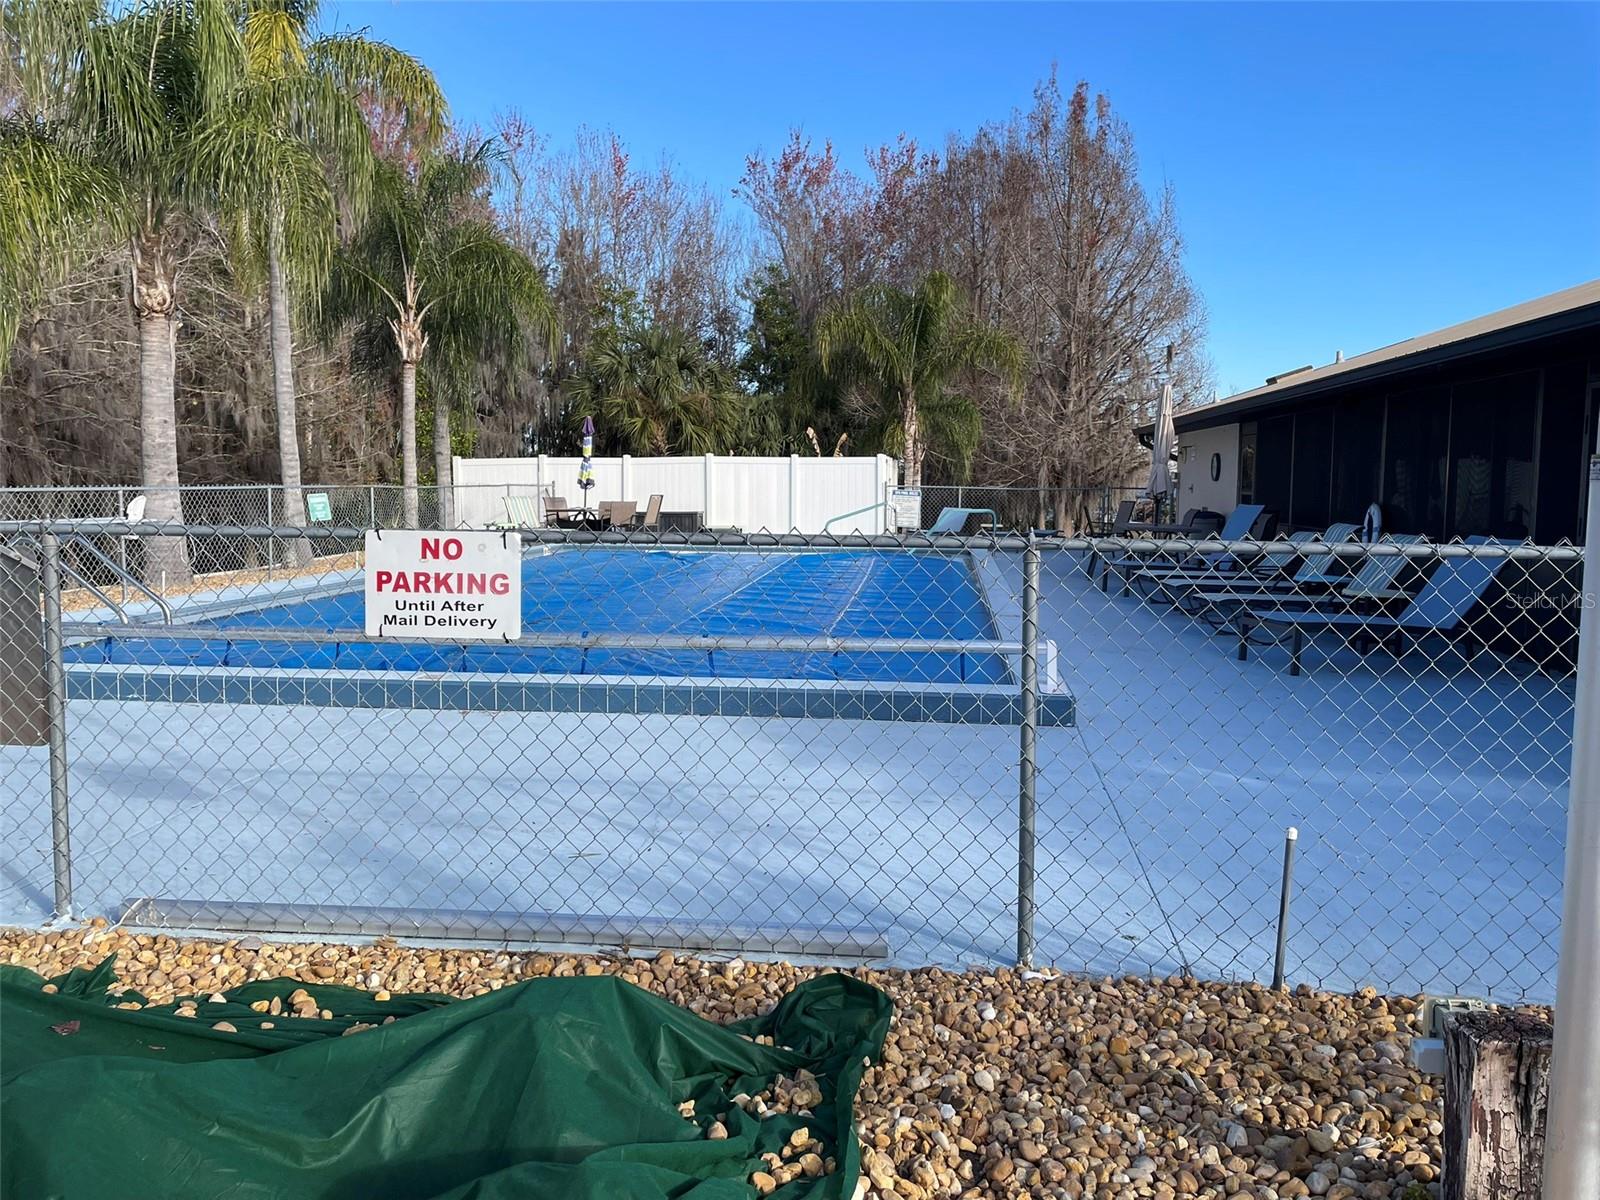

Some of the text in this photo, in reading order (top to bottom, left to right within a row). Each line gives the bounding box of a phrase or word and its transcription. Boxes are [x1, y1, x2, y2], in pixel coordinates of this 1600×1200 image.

[421, 538, 463, 560] NO
[376, 571, 510, 595] PARKING
[395, 600, 485, 612] Until After
[383, 614, 497, 629] Mail Delivery
